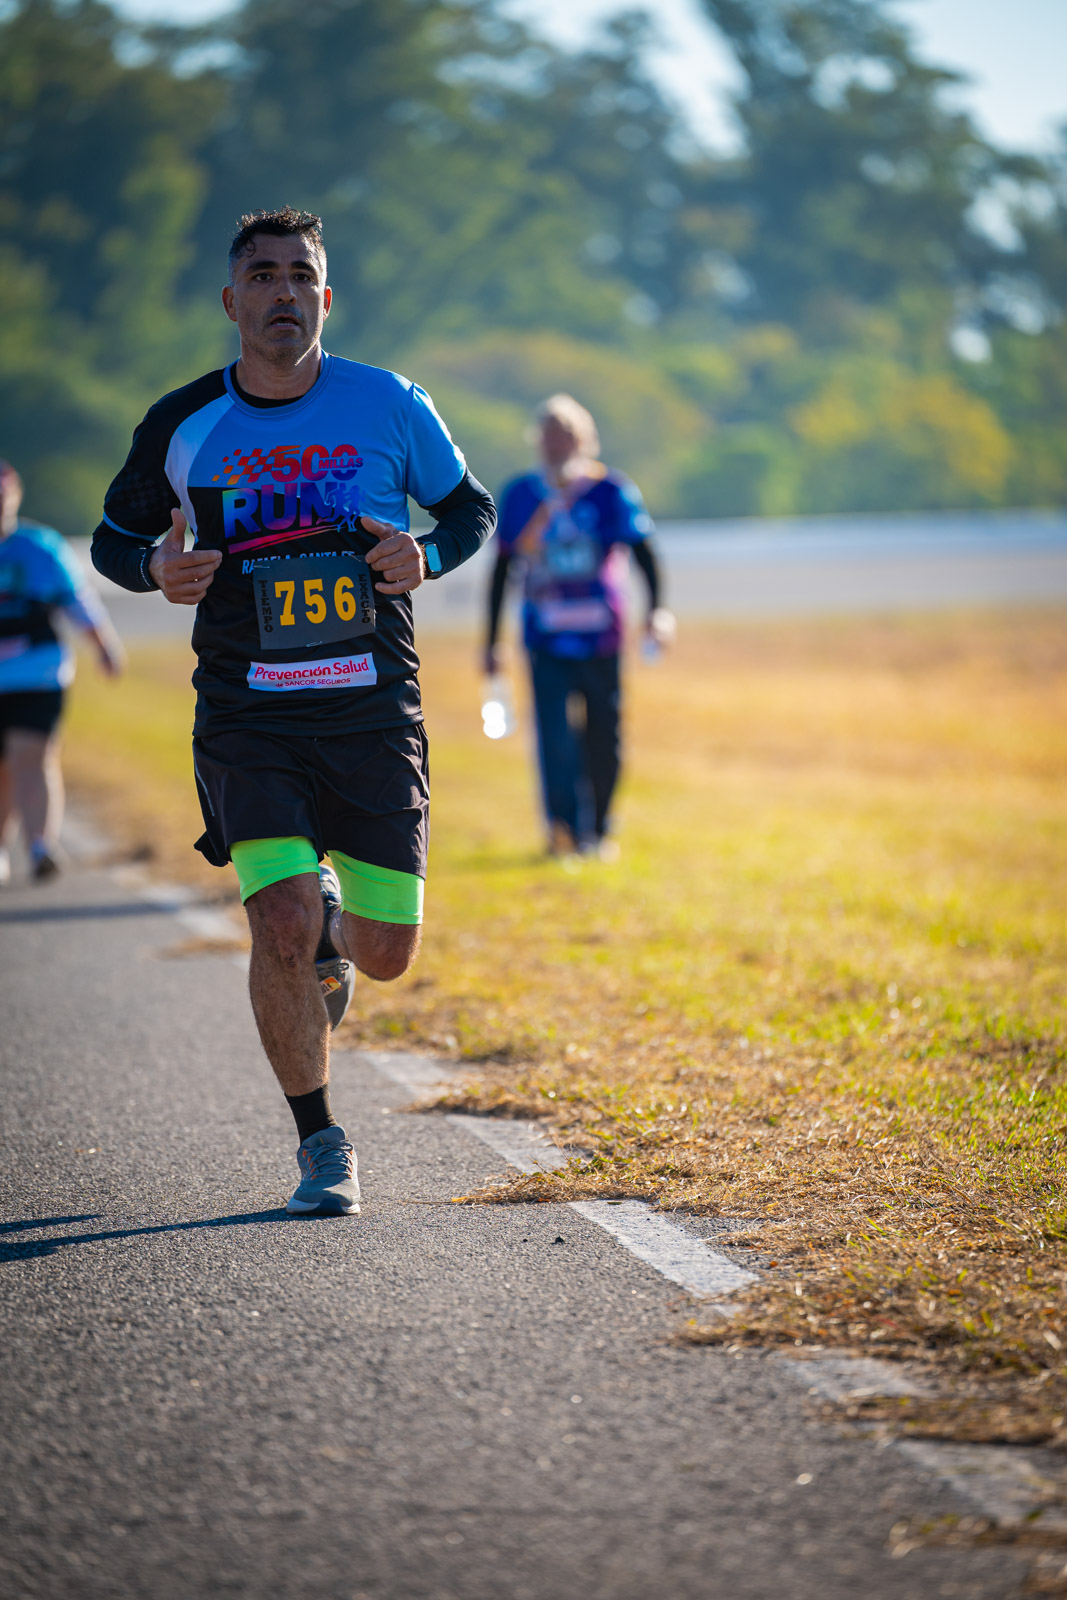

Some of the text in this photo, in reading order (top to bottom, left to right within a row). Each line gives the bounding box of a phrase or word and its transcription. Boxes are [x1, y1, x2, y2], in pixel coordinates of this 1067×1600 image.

[270, 443, 359, 483] 500
[318, 457, 364, 469] MILLAS
[221, 482, 338, 539] RUN
[258, 579, 273, 633] TIEMPO
[274, 576, 357, 627] 756
[358, 573, 371, 624] EXACTO
[254, 657, 370, 680] Prevención Salud
[285, 679, 315, 687] SANCOR
[317, 677, 351, 685] SEGUROS
